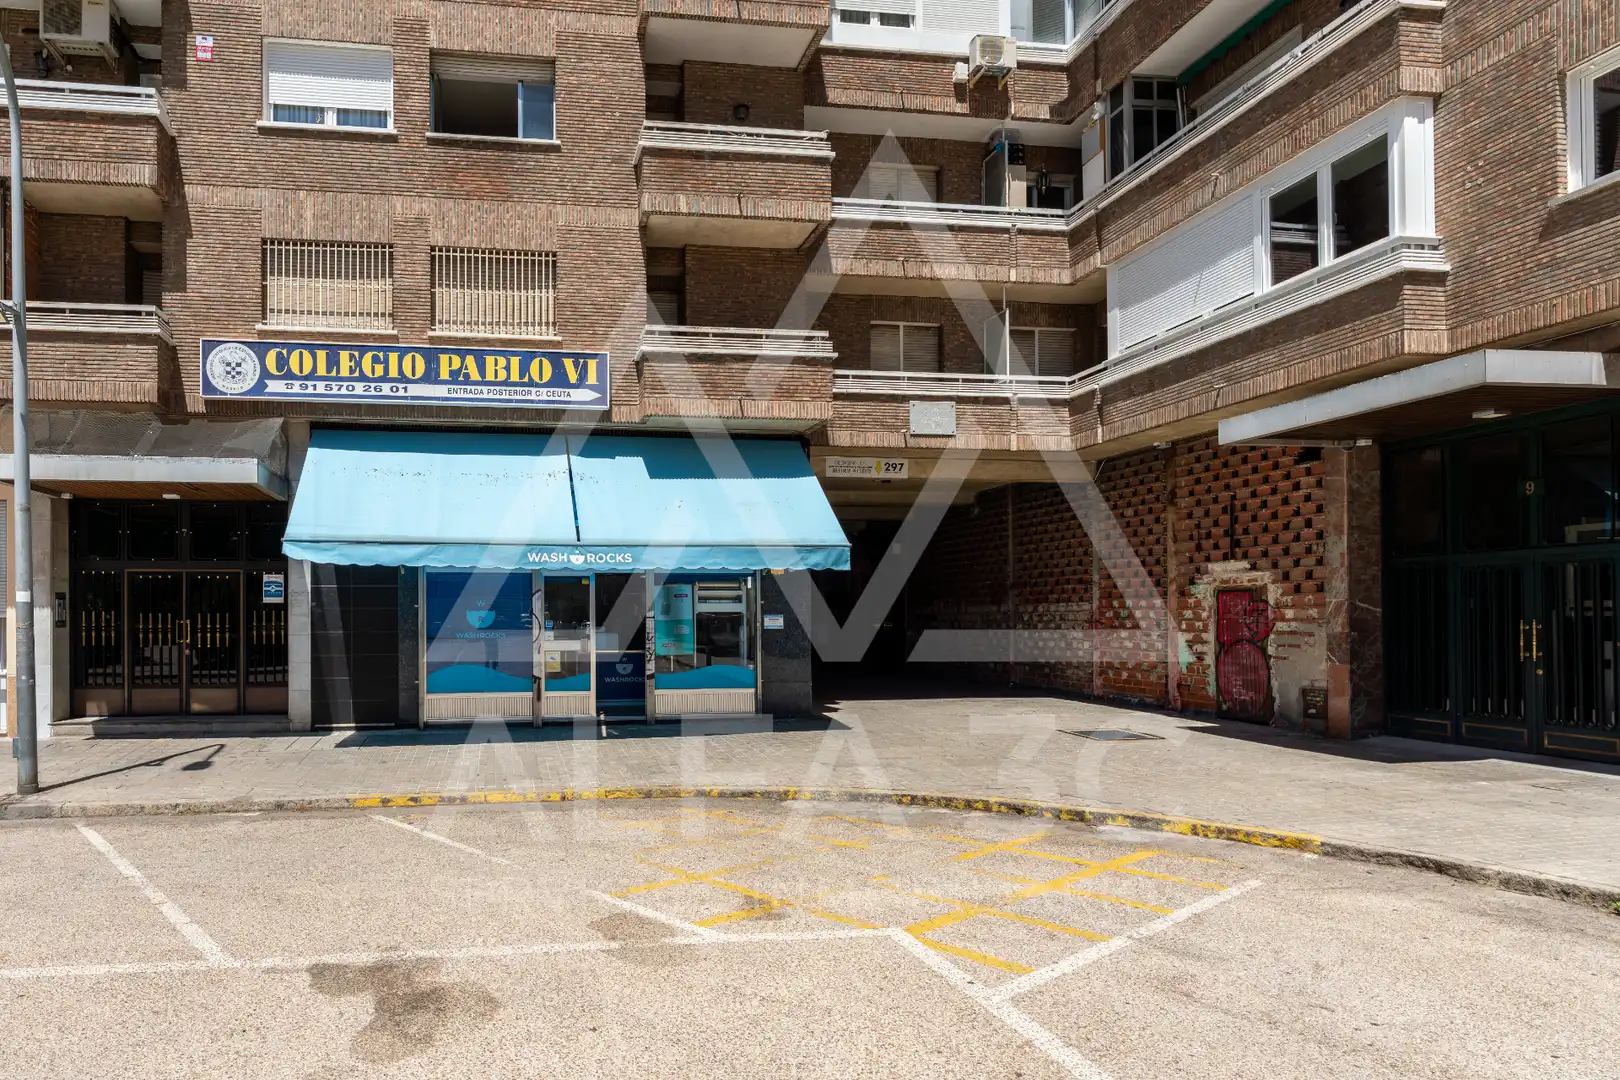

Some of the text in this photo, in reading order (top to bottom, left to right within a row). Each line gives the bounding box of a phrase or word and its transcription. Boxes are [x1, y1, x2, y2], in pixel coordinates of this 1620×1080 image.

[265, 348, 600, 385] COLEGIO PABLO VI
[299, 383, 409, 394] 91 570 26 01
[447, 387, 484, 397] ENTRADA
[486, 388, 532, 397] POSTERIOR
[546, 390, 572, 398] CEUTA
[884, 462, 904, 472] 297
[1526, 481, 1535, 495] 9
[527, 552, 633, 563] WASH ROCKS
